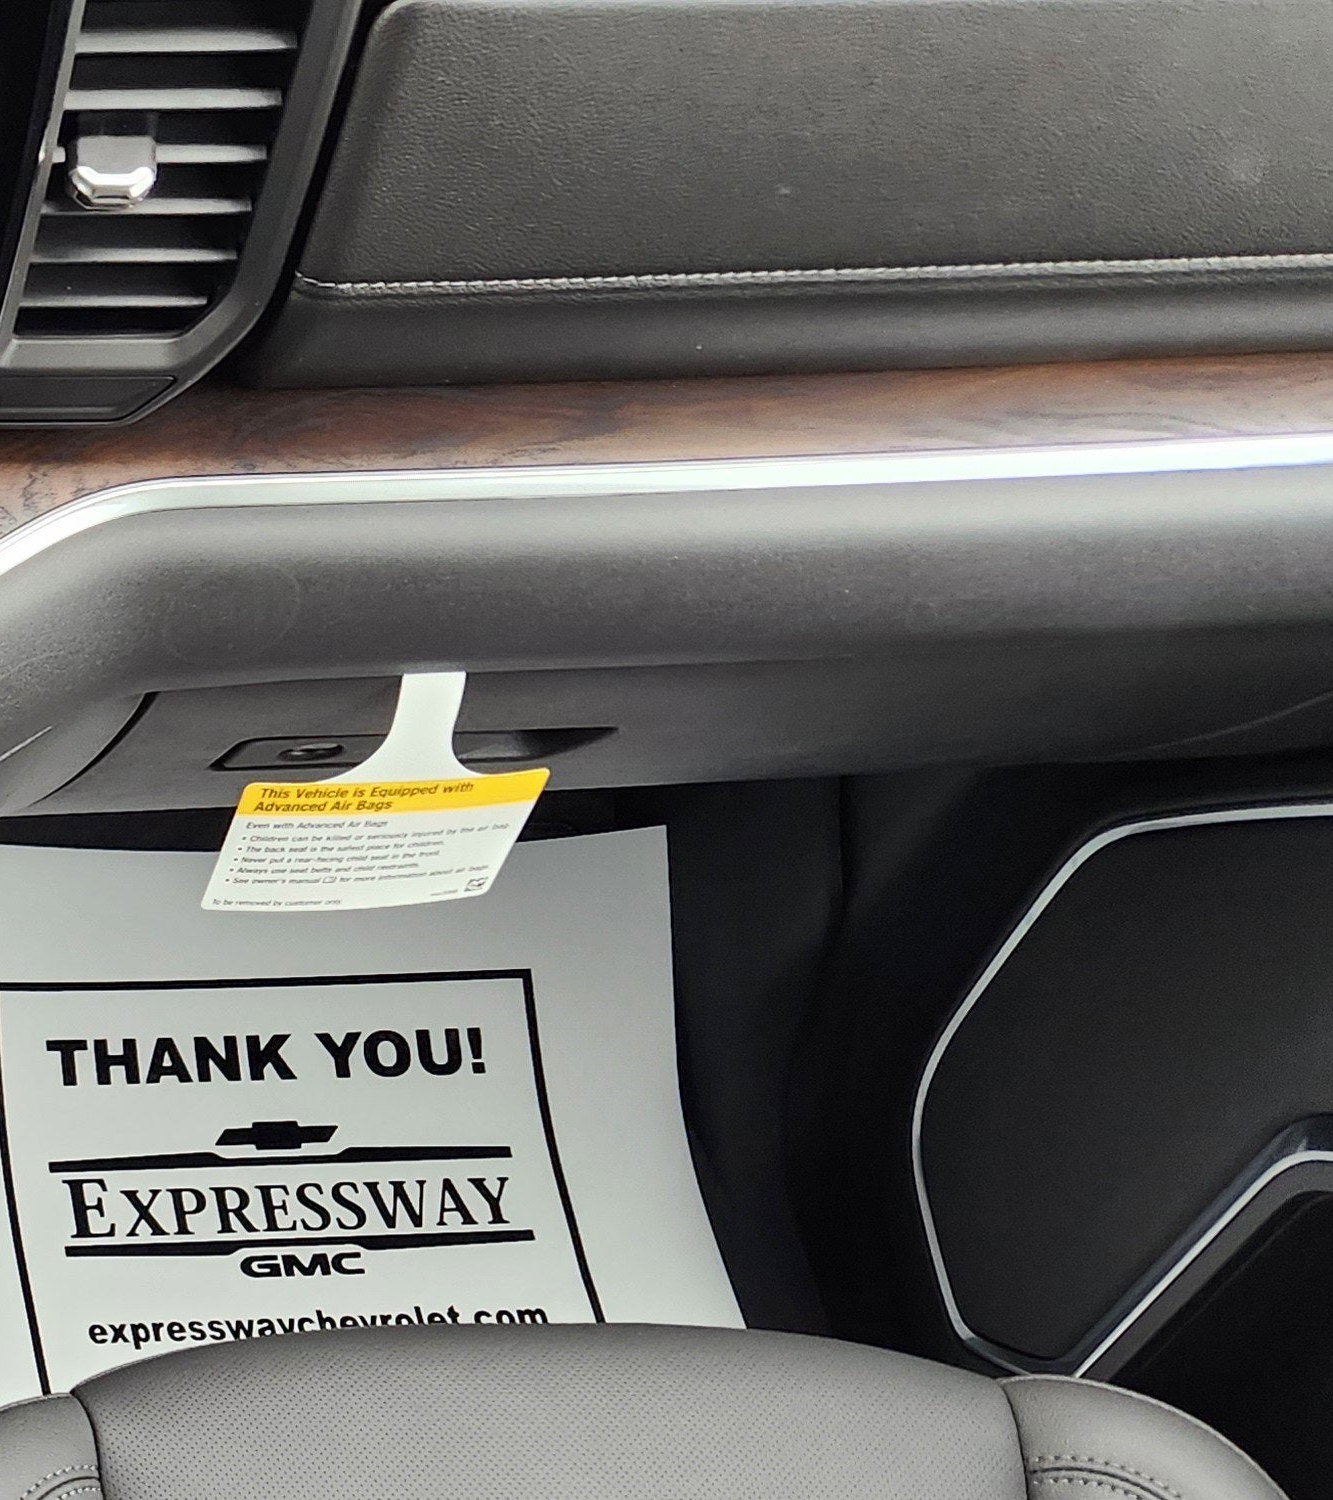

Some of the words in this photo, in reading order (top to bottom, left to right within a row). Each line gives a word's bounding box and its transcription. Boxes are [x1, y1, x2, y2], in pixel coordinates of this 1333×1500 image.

[260, 788, 290, 799] This
[296, 787, 348, 799] Vehicle
[352, 787, 365, 798] is
[370, 784, 438, 799] Equipped
[442, 781, 475, 794] with
[253, 800, 326, 812] Advanced
[329, 800, 351, 811] Air
[356, 800, 393, 812] Bags
[297, 822, 345, 830] Advanced
[46, 1033, 298, 1087] THANK
[314, 1027, 487, 1079] YOU!
[61, 1176, 511, 1240] EXPRESSWAY
[239, 1251, 366, 1278] GMC
[87, 1304, 549, 1350] expresswaychevroletcom
